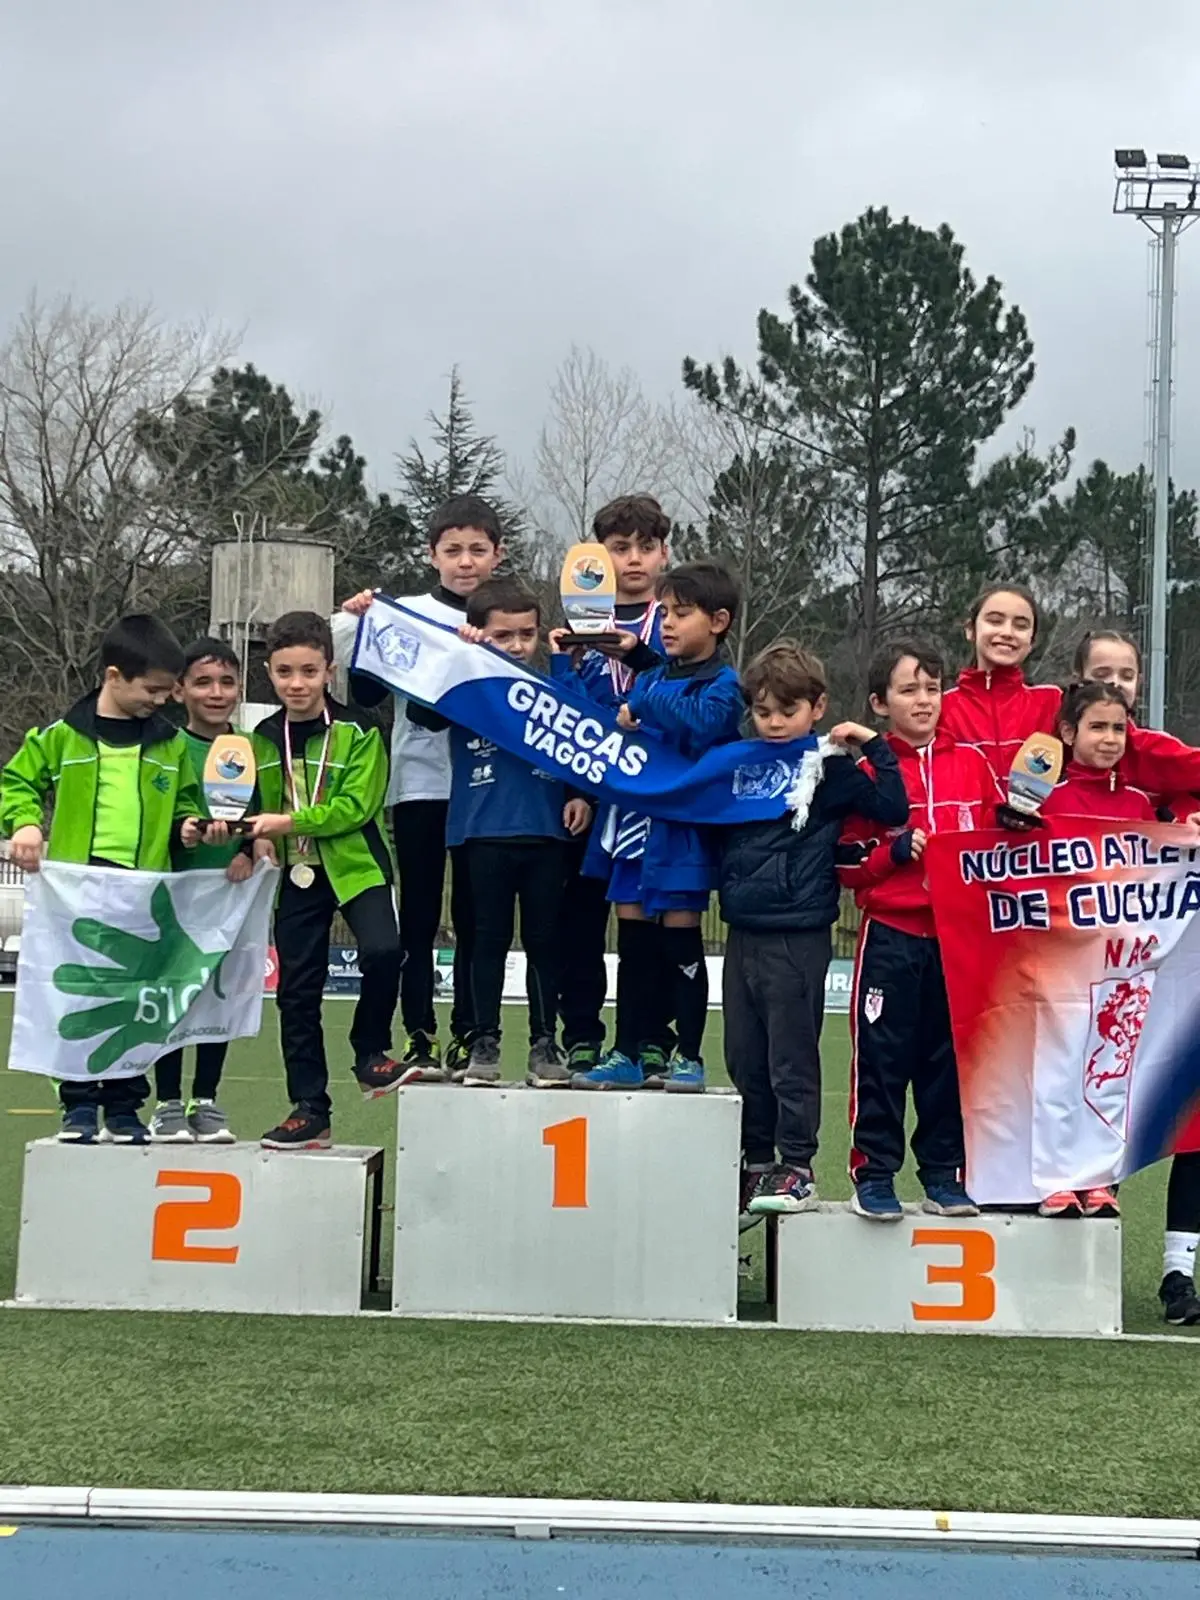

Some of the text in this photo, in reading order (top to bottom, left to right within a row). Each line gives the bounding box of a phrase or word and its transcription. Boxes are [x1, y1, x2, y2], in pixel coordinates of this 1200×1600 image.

[507, 680, 648, 776] GRECAS
[523, 719, 607, 784] VAGOS
[960, 838, 1097, 884] NÚCLEO
[987, 870, 1200, 933] DE CUCUJÃ
[541, 1116, 589, 1209] 1
[151, 1169, 242, 1264] 2
[910, 1228, 996, 1322] 3
